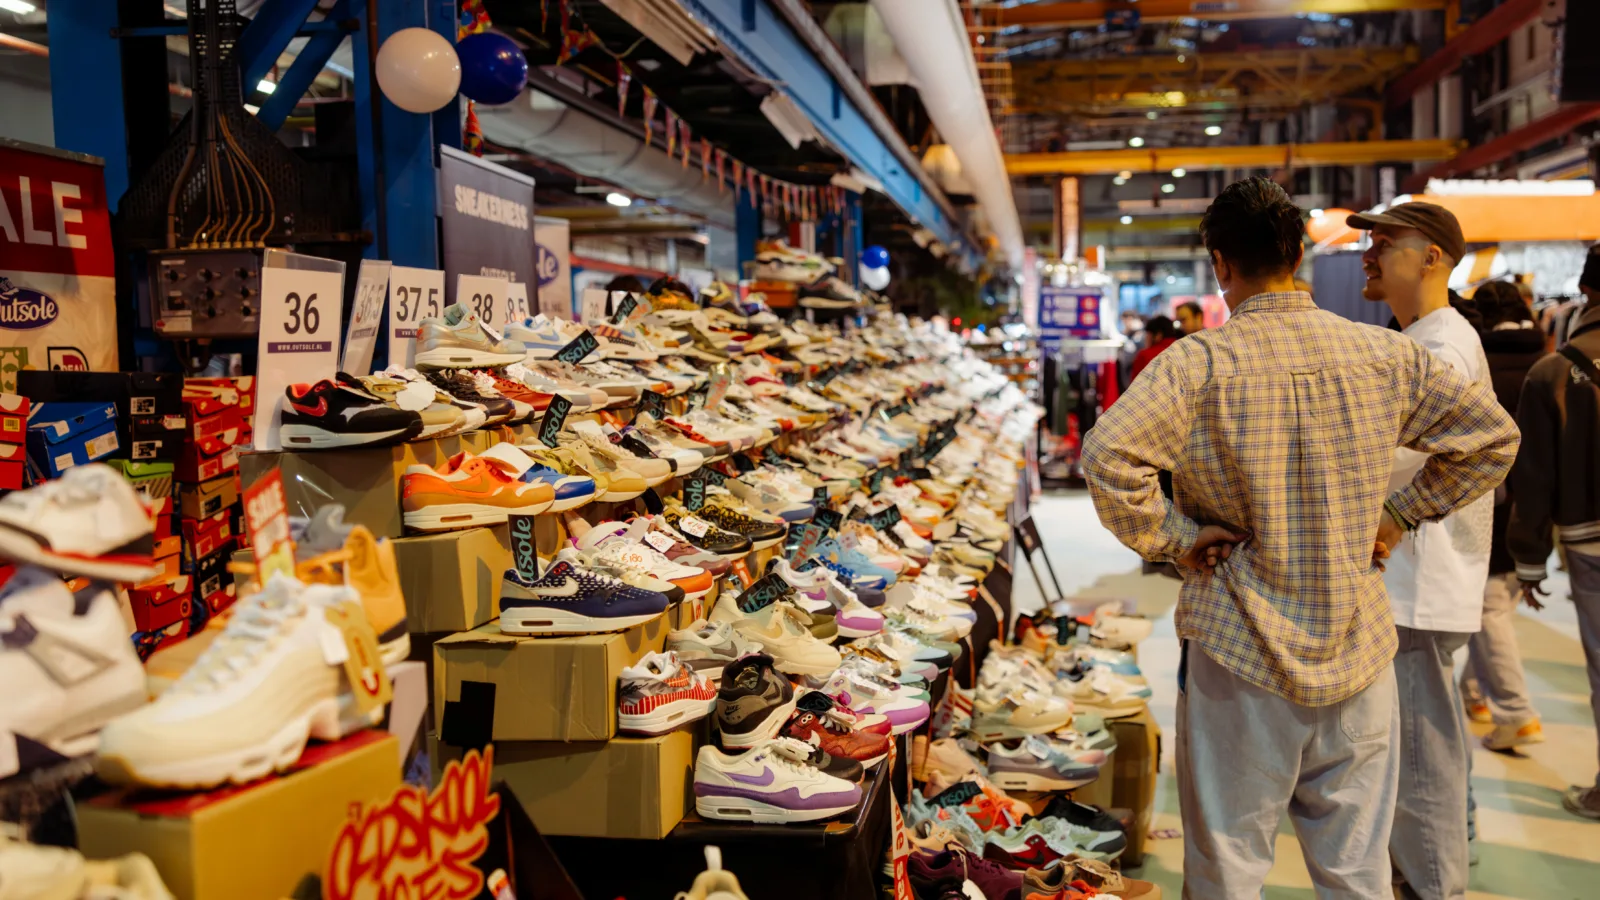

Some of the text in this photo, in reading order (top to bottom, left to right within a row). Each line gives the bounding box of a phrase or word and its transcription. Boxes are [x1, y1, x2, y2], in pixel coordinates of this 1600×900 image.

[455, 184, 529, 231] SNEAKERNESS
[284, 292, 320, 335] 36
[471, 293, 493, 325] 38
[277, 343, 323, 352] WWW.OUTSOLE.NL
